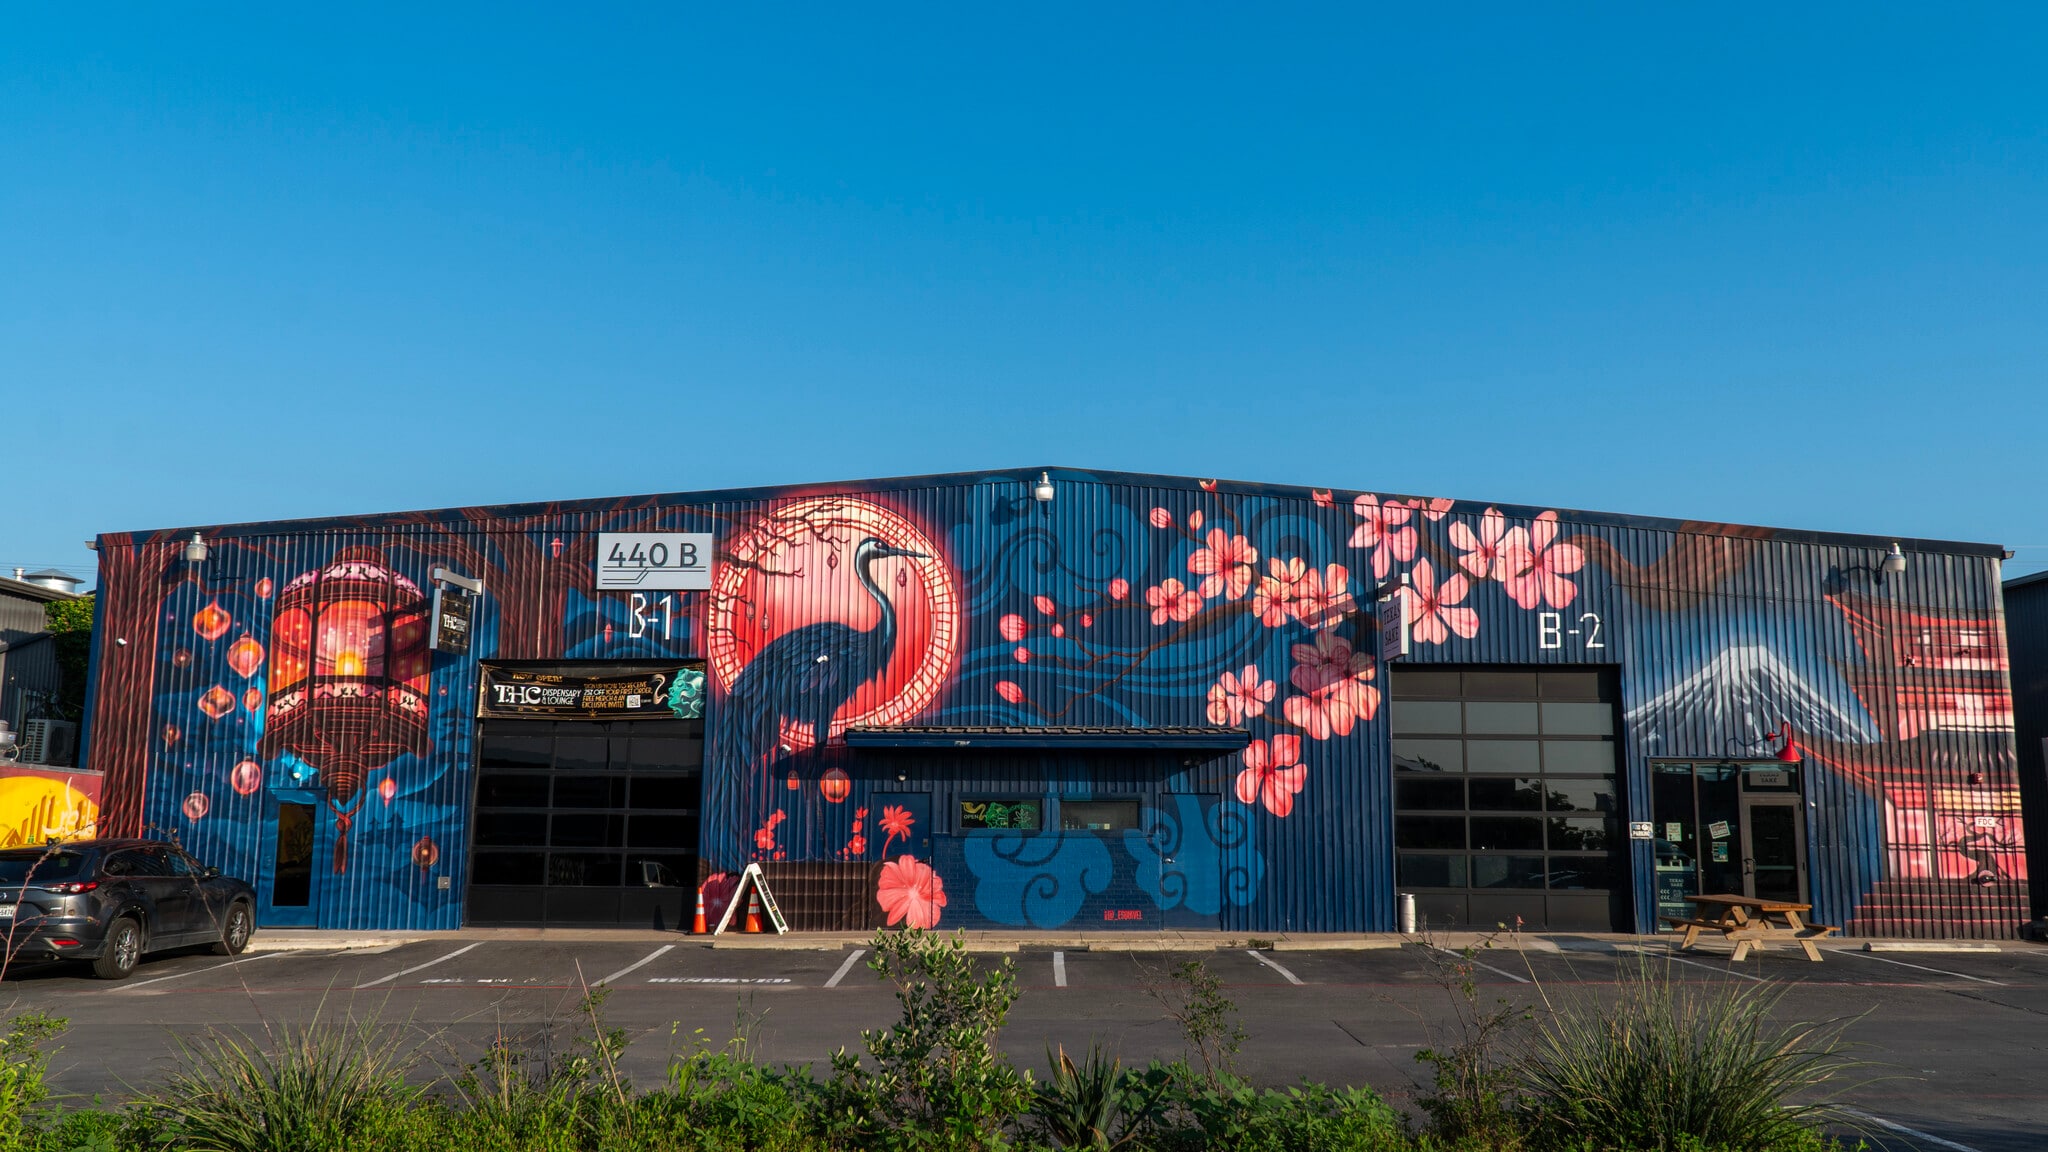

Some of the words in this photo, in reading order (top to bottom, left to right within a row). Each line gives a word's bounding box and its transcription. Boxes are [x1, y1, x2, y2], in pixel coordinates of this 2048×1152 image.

[607, 542, 669, 568] 440
[680, 542, 708, 568] B
[629, 592, 672, 641] B-1
[1384, 603, 1400, 625] TEXAS
[1540, 612, 1604, 649] B-2
[542, 688, 582, 697] DISPENSARY
[547, 696, 574, 705] LOUNGE
